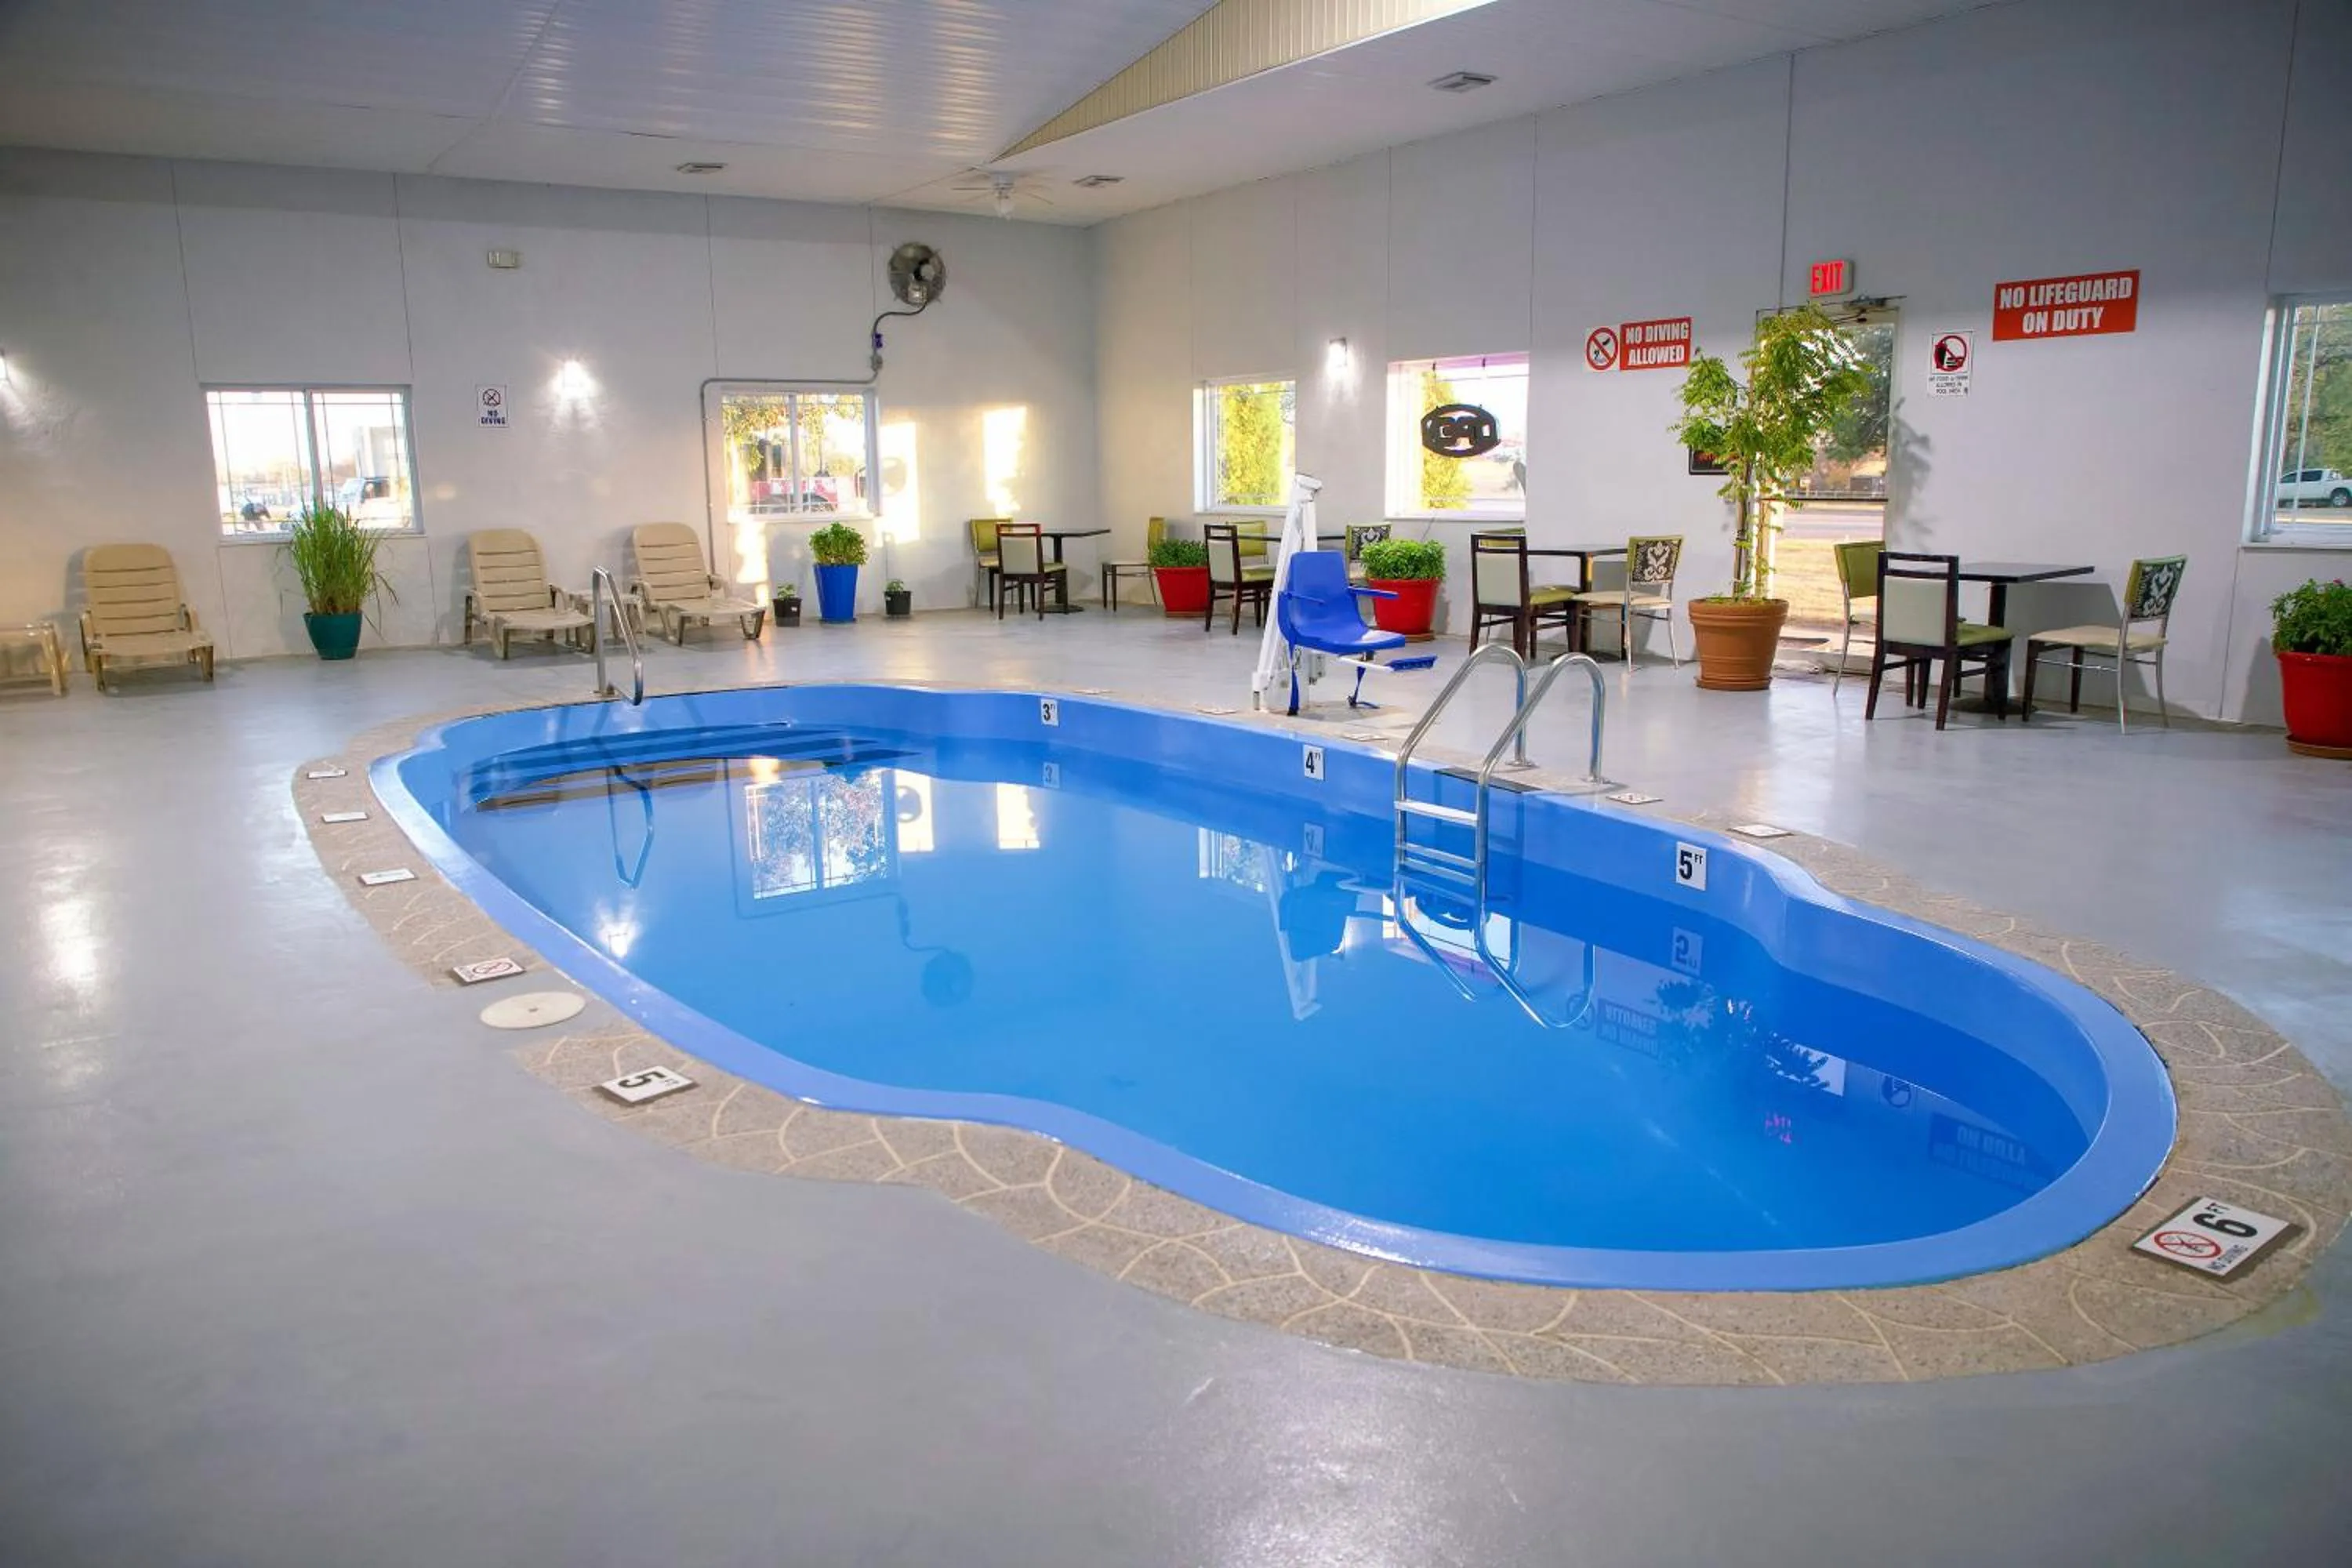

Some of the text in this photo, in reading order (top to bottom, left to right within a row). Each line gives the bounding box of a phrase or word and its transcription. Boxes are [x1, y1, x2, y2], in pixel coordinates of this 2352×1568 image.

[1811, 261, 1843, 294] EXIT
[2000, 277, 2132, 310] NO LIFEGUARD
[1625, 321, 1689, 344] NO DIVING
[2023, 307, 2104, 334] ON DUTY
[1628, 344, 1686, 366] ALLOWED
[1043, 703, 1051, 722] 3
[1305, 751, 1315, 774] 4
[1679, 849, 1693, 880] 5
[617, 1071, 667, 1089] 5
[2192, 1212, 2259, 1238] 6
